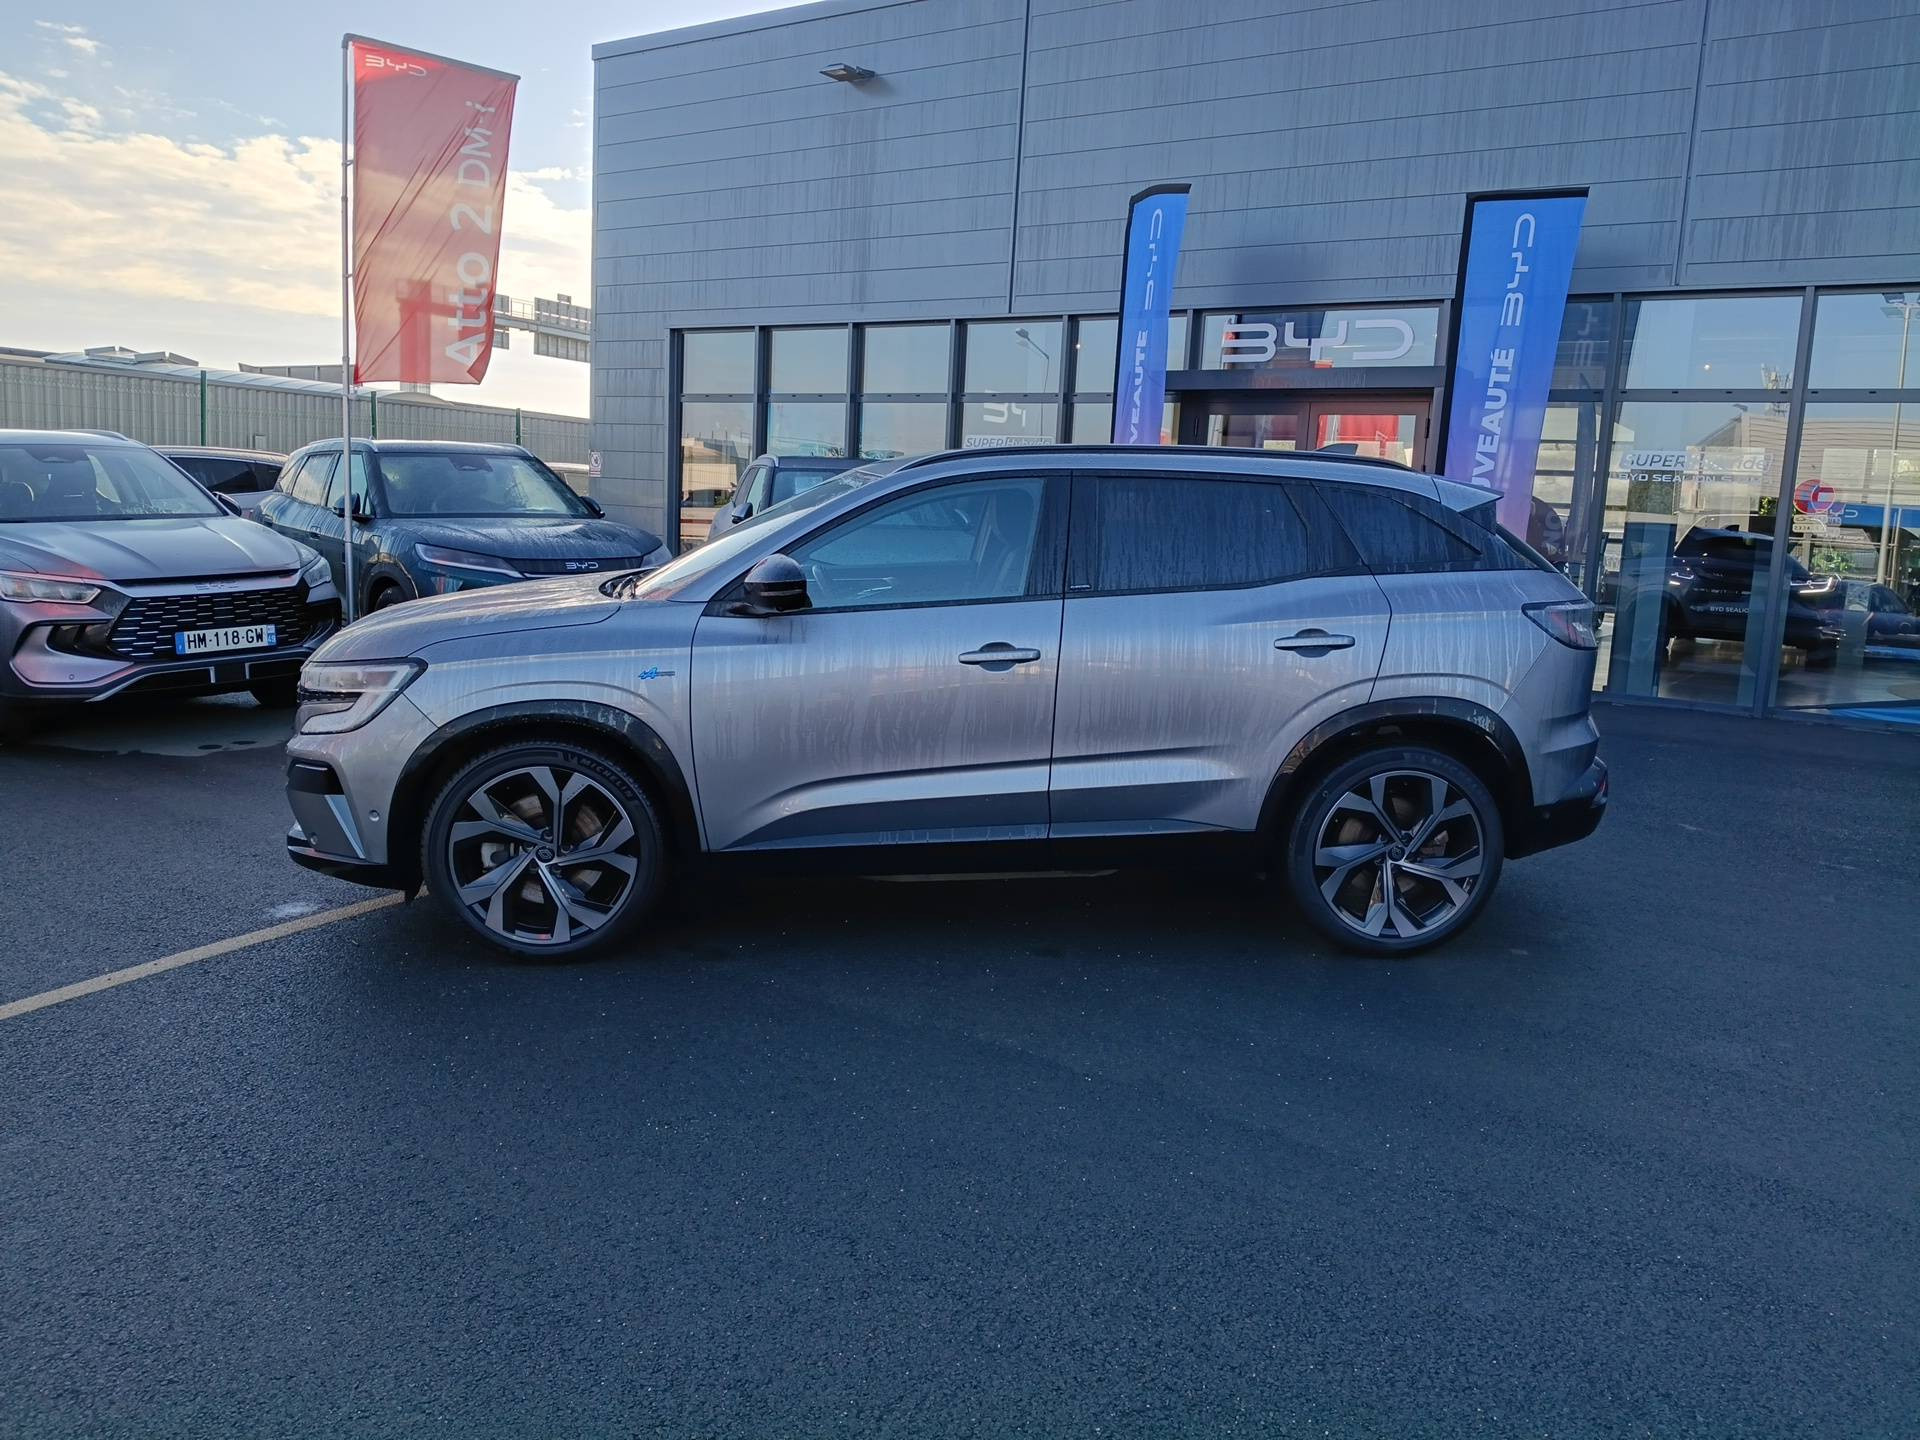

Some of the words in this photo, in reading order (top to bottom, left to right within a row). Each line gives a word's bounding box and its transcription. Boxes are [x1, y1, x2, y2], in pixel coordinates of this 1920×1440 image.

[364, 53, 428, 77] BYD
[452, 202, 494, 235] 2
[1144, 208, 1163, 311] BYD
[1500, 213, 1536, 326] BYD
[445, 252, 491, 366] Atto
[1221, 318, 1415, 363] BYD
[1625, 453, 1686, 468] SUPER
[1618, 473, 1649, 482] BYD
[565, 561, 599, 570] BYD
[1725, 606, 1750, 614] SEALIO
[186, 627, 264, 650] HM-118-GW
[580, 757, 635, 798] MICHELIN
